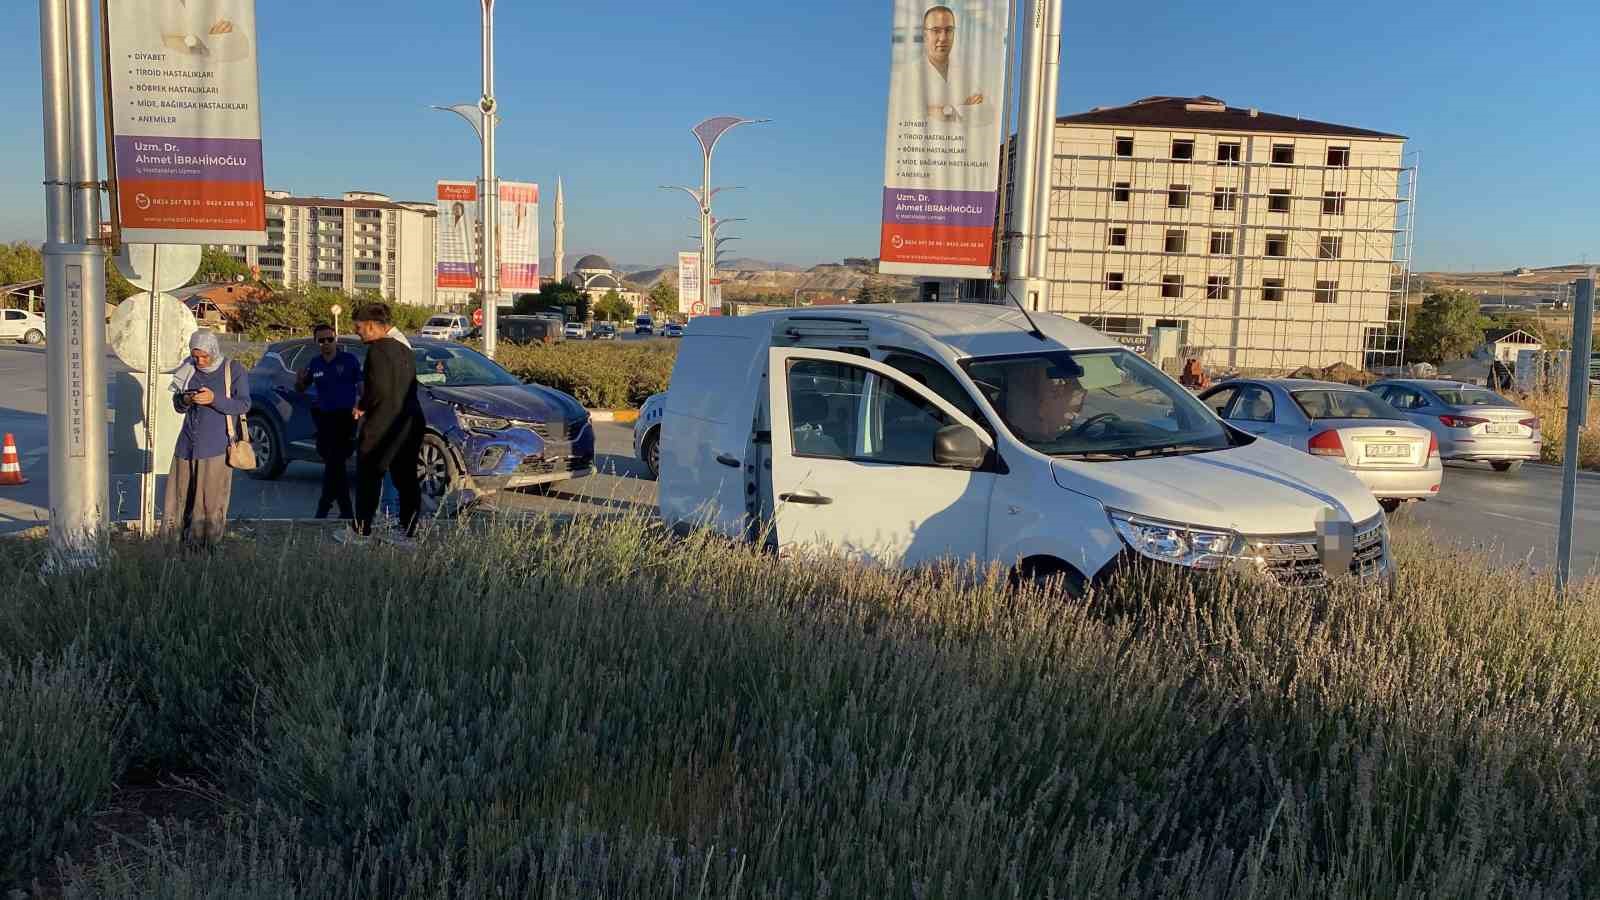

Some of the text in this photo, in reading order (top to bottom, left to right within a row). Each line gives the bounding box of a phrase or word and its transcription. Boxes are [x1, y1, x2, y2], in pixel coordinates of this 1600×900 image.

[134, 51, 166, 61] DİYABET
[136, 68, 214, 78] TİROİD HASTALIKLARI
[136, 84, 219, 94] BÖBREK HASTALIKLARI
[160, 100, 197, 109] BAĞIRSAK
[198, 102, 248, 110] HASTALIKLARI
[138, 115, 177, 124] ANEMİLER
[134, 142, 180, 152] Uzm. Dr.
[135, 152, 247, 166] Ahmet İBRAHİMOĞLU
[896, 193, 930, 202] Uzm. Dr.
[895, 203, 922, 212] Ahmet
